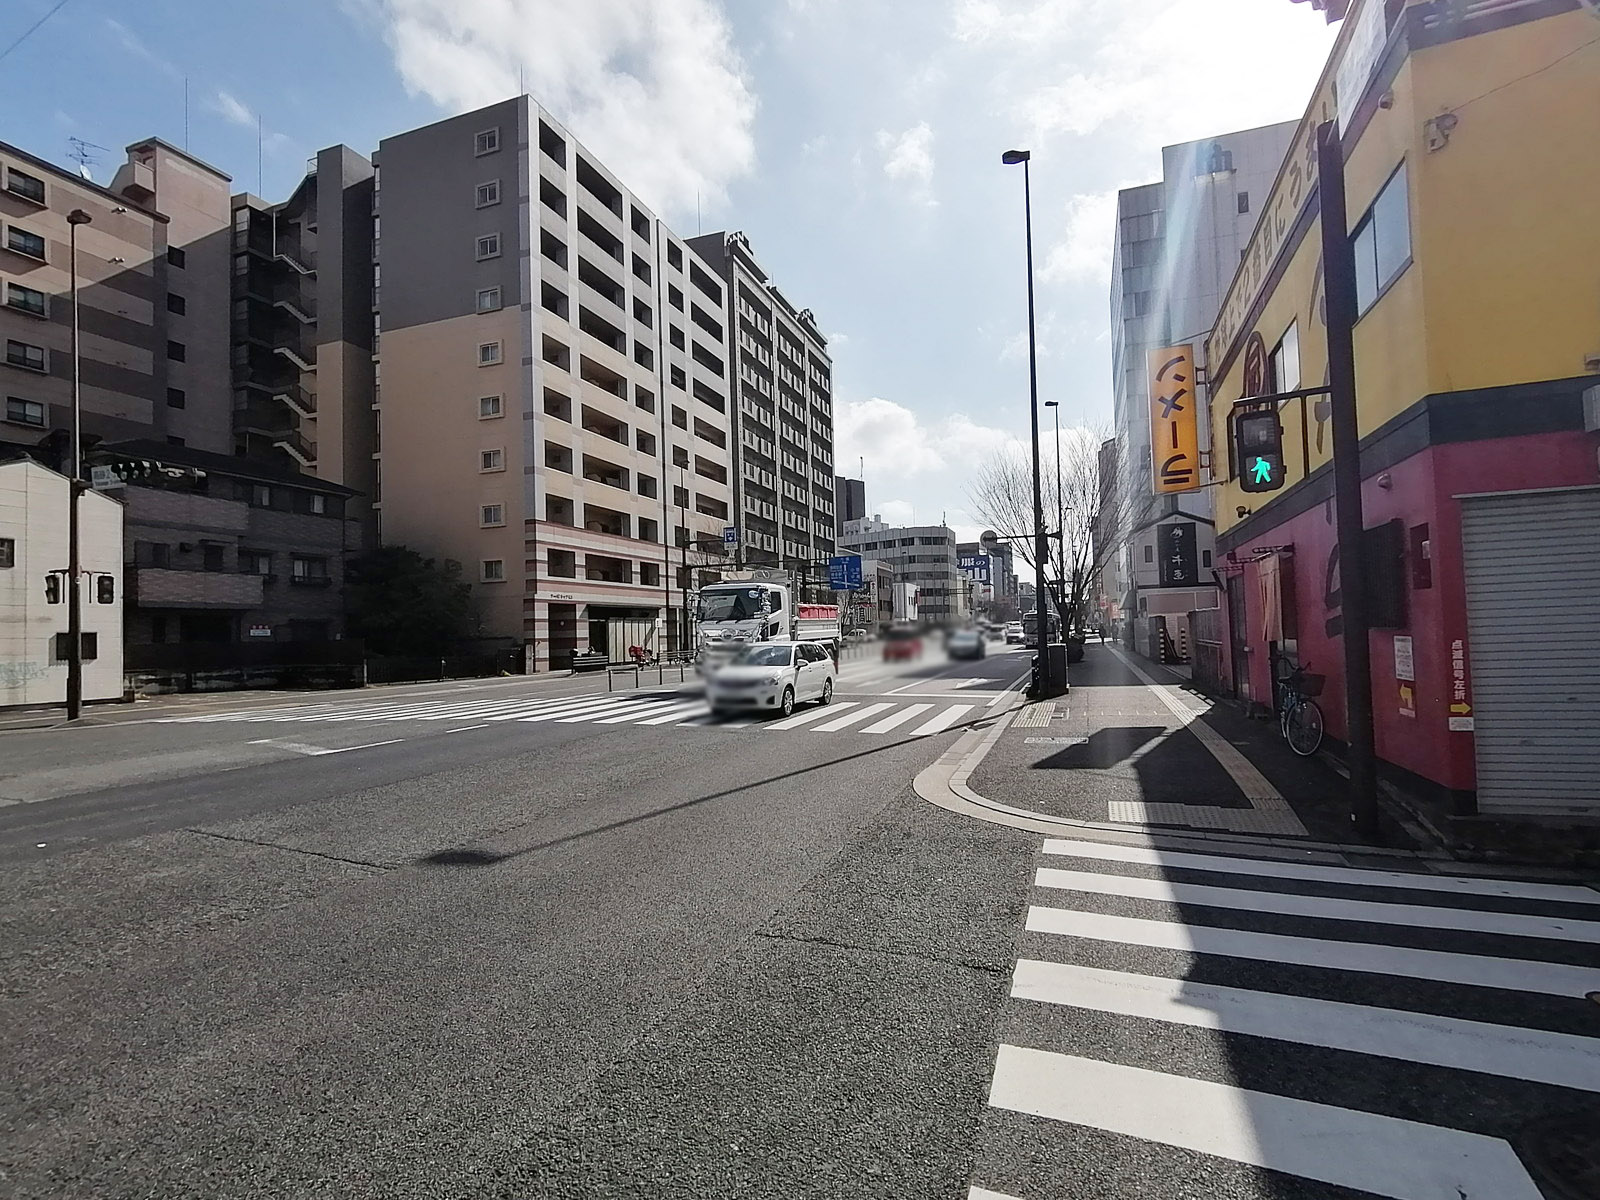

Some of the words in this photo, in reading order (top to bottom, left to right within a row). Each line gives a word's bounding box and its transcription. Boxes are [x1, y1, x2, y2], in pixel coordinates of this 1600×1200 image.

[957, 557, 986, 567] 服の
[1451, 639, 1466, 700] 点滅信号左折
